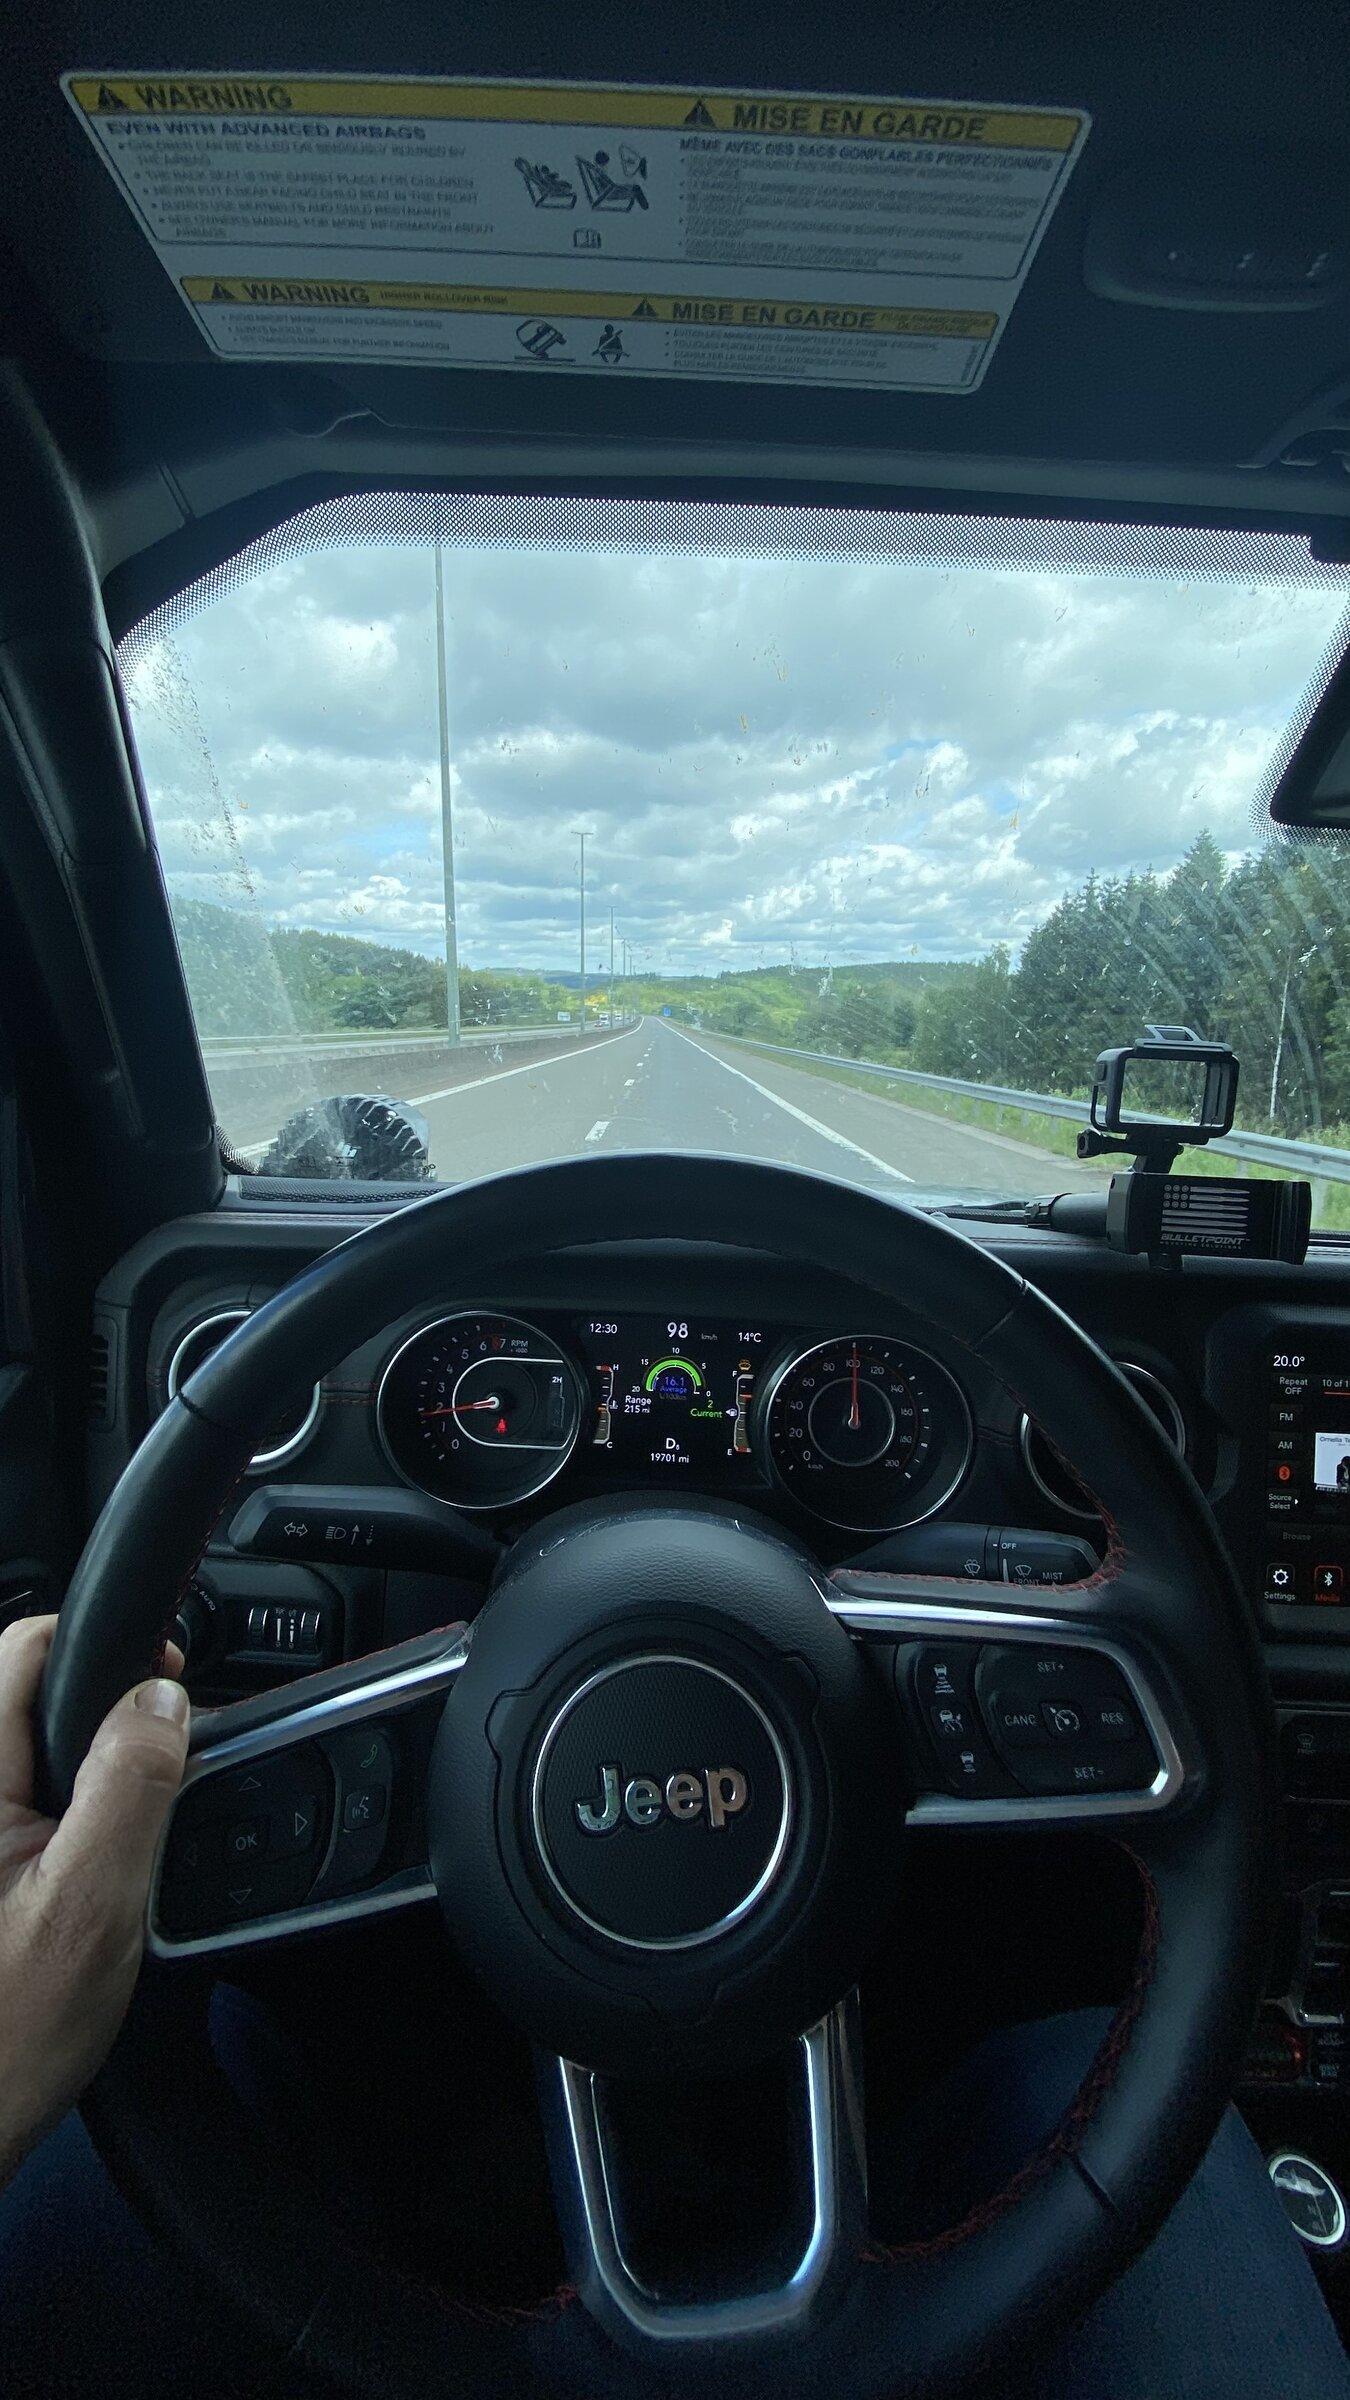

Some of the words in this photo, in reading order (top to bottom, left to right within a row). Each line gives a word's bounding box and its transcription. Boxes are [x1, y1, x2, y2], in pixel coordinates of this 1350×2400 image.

[135, 83, 293, 110] WARNING
[733, 102, 811, 130] MISE
[819, 107, 864, 134] EN
[873, 110, 987, 140] GARDE
[106, 121, 161, 135] EVEN
[165, 122, 216, 135] WITH
[222, 122, 330, 137] ADVANCED
[336, 125, 426, 140] AIRBAGS
[240, 282, 370, 304] WARNING
[672, 302, 734, 321] MISE
[743, 305, 776, 323] EN
[784, 307, 876, 330] GARDE
[1161, 1233, 1245, 1245] BULLETPOINT
[590, 1322, 618, 1335] 12:30
[667, 1322, 689, 1339] 98
[480, 1341, 487, 1351] 6
[499, 1338, 506, 1349] 7
[511, 1340, 529, 1348] RPM
[461, 1348, 470, 1360] 5
[672, 1347, 680, 1355] 10
[641, 1358, 649, 1366] 15
[1273, 1355, 1305, 1367] 20.0°
[446, 1364, 454, 1375] 4
[822, 1362, 836, 1372] 80
[870, 1366, 885, 1375] 120
[802, 1378, 815, 1388] 60
[1279, 1376, 1308, 1386] Repeat
[1322, 1379, 1332, 1387] 10
[1334, 1380, 1343, 1388] of
[438, 1382, 446, 1393] 3
[1285, 1387, 1302, 1395] OFF
[625, 1395, 652, 1406] Range
[789, 1400, 804, 1411] 40
[624, 1405, 640, 1413] 215
[690, 1408, 723, 1419] Current
[1279, 1413, 1293, 1421] FM
[789, 1428, 804, 1439] 20
[451, 1439, 460, 1450] 0
[1278, 1441, 1293, 1450] AM
[650, 1453, 676, 1463] 19701
[678, 1454, 690, 1463] mi
[802, 1450, 811, 1461] 0
[1268, 1493, 1292, 1501] Source
[1269, 1502, 1291, 1510] Select
[1282, 1531, 1311, 1541] Browse
[1001, 1542, 1017, 1550] OFF
[1042, 1571, 1063, 1581] MIST
[198, 1590, 216, 1611] AUTO
[1264, 1591, 1296, 1601] Settings
[1004, 1714, 1039, 1726] CANC
[575, 1765, 748, 1832] Jeep
[234, 1832, 258, 1851] OK
